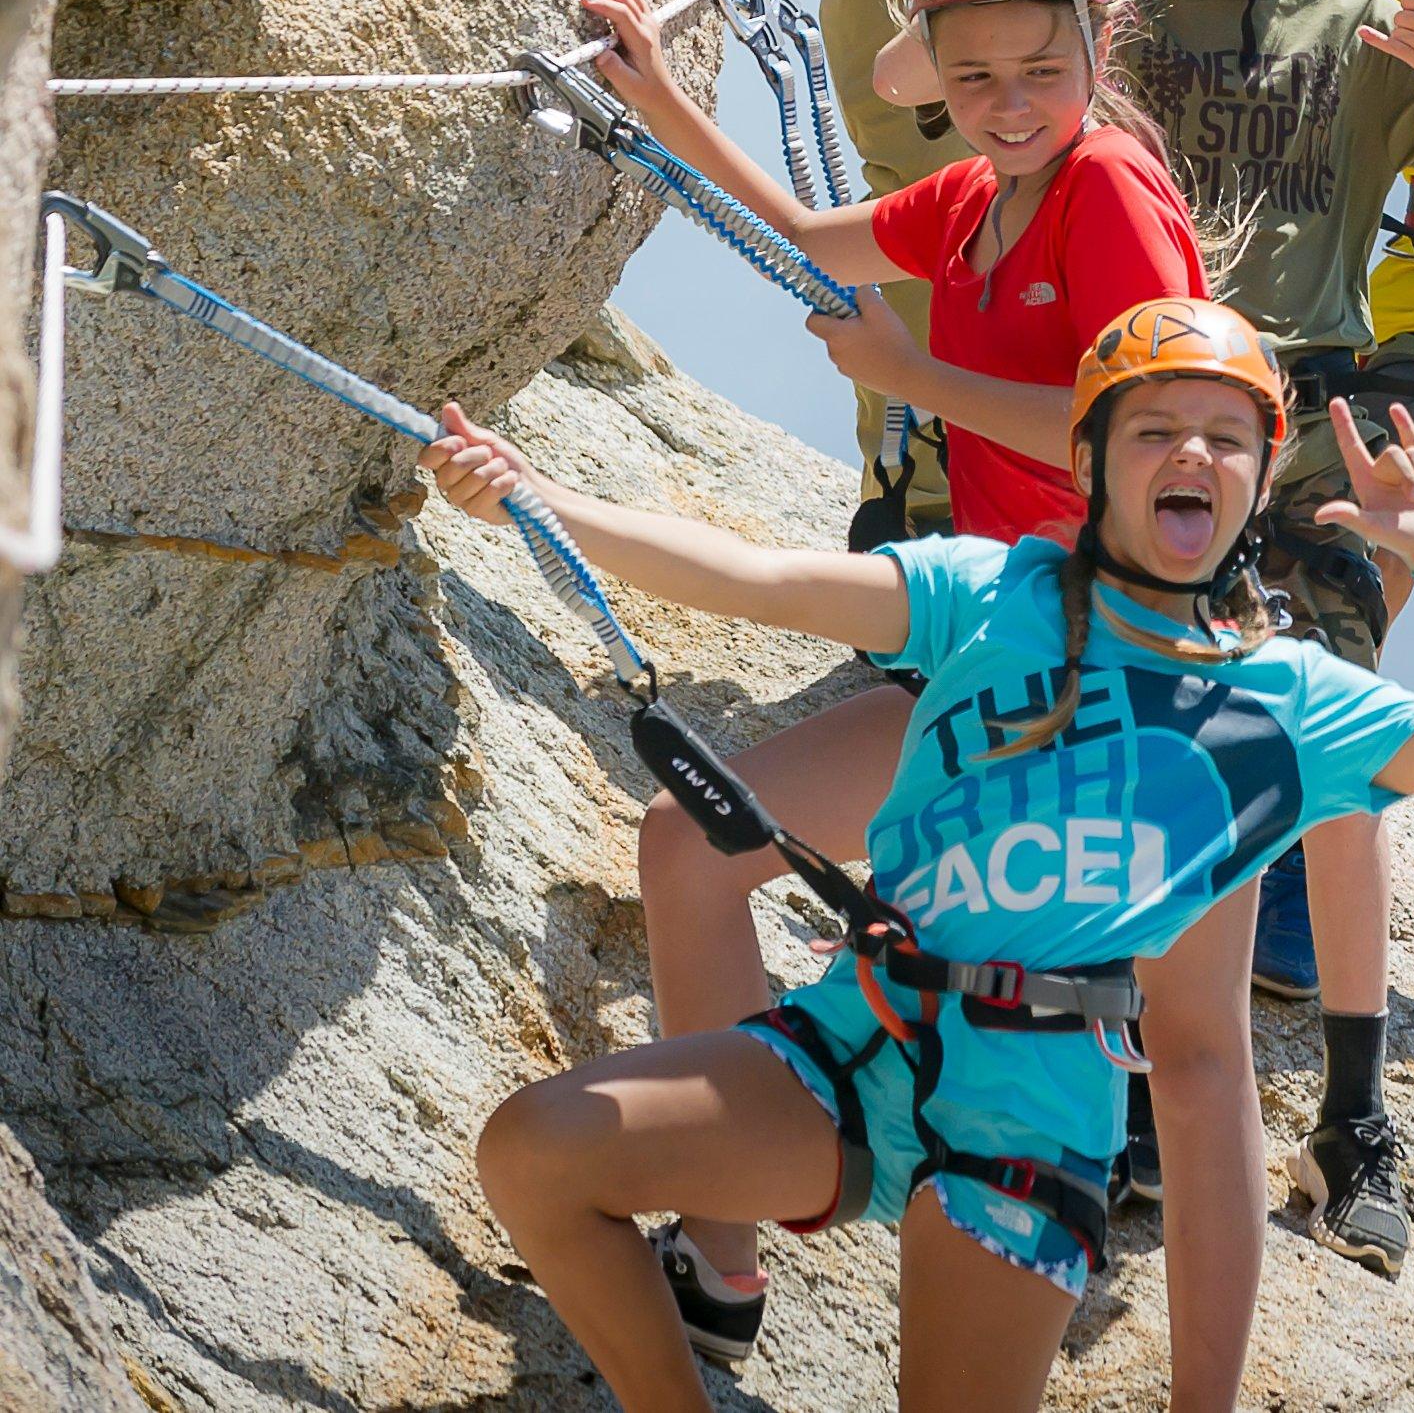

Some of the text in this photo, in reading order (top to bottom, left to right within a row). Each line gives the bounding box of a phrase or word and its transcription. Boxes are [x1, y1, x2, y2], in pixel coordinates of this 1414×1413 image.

[1172, 48, 1318, 106] NEVER
[1196, 99, 1300, 160] STOP
[922, 664, 1124, 779] THE
[671, 756, 732, 816] CAMP
[868, 738, 1128, 889] ORTH
[892, 817, 1124, 929] FACE
